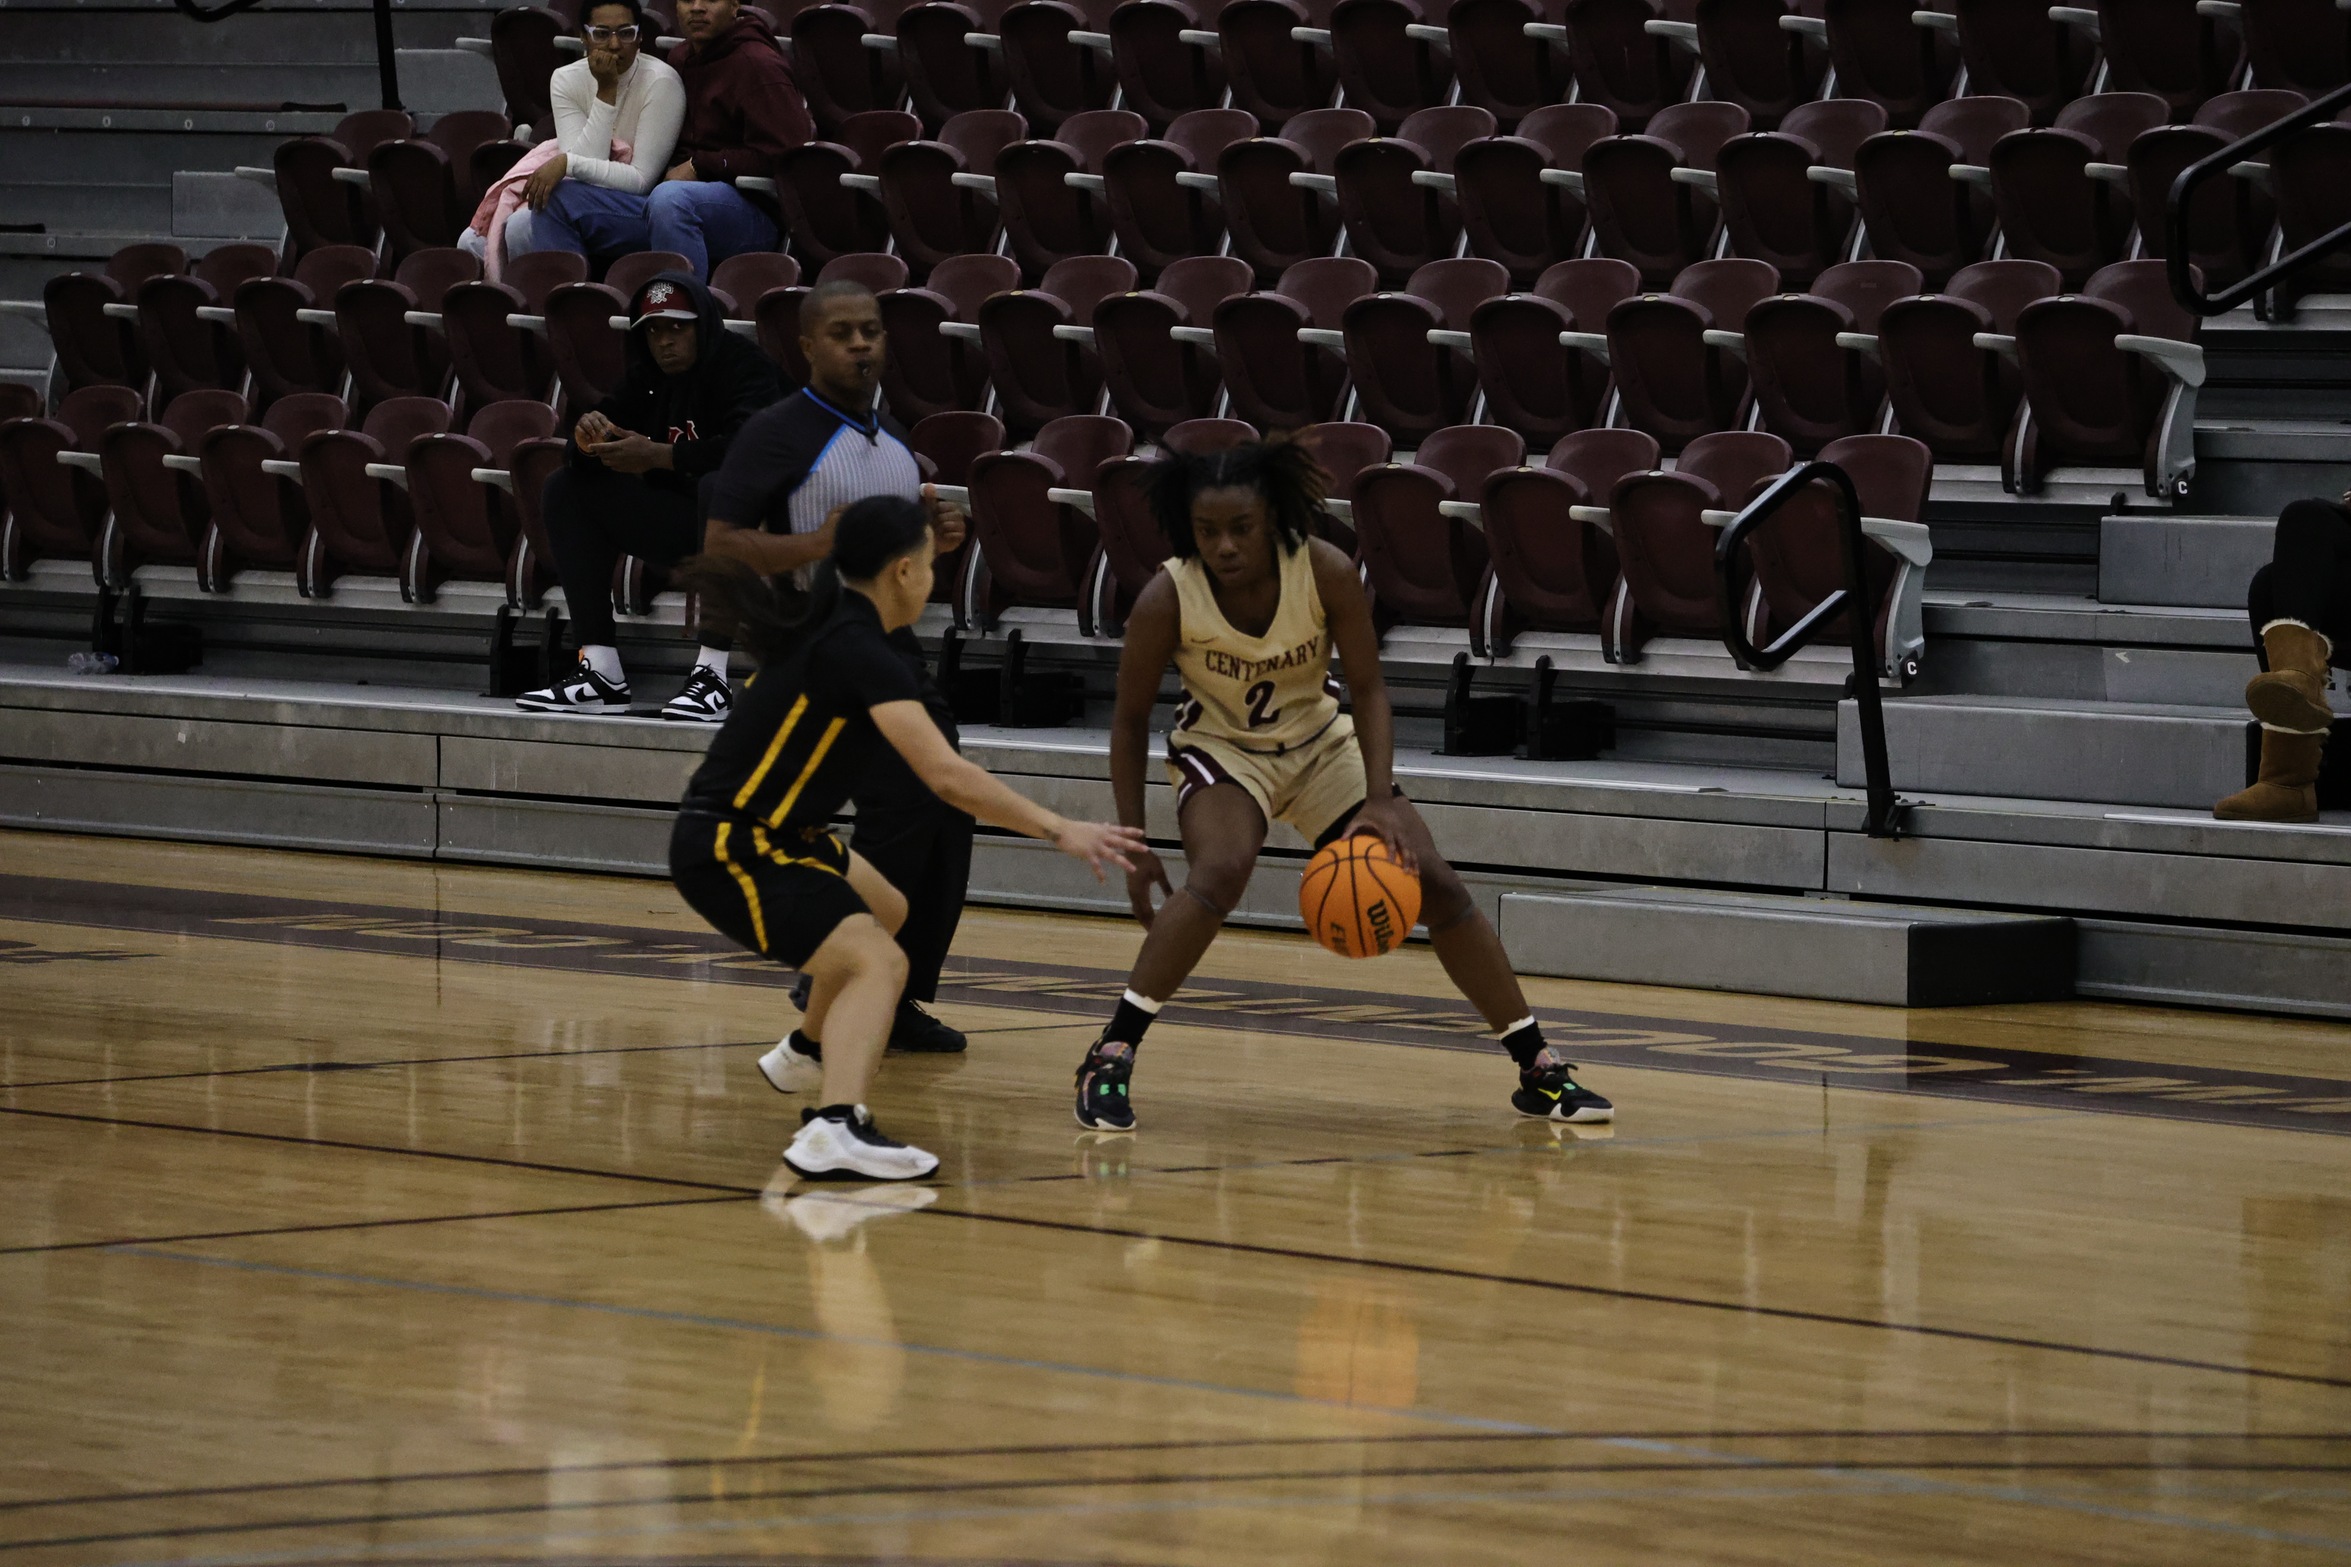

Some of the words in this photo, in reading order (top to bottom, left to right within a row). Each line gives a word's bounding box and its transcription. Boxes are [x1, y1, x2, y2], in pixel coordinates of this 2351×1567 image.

[2178, 481, 2188, 495] C
[1205, 635, 1320, 682] CENTENARY
[1907, 661, 1917, 675] C
[1244, 680, 1283, 728] 2
